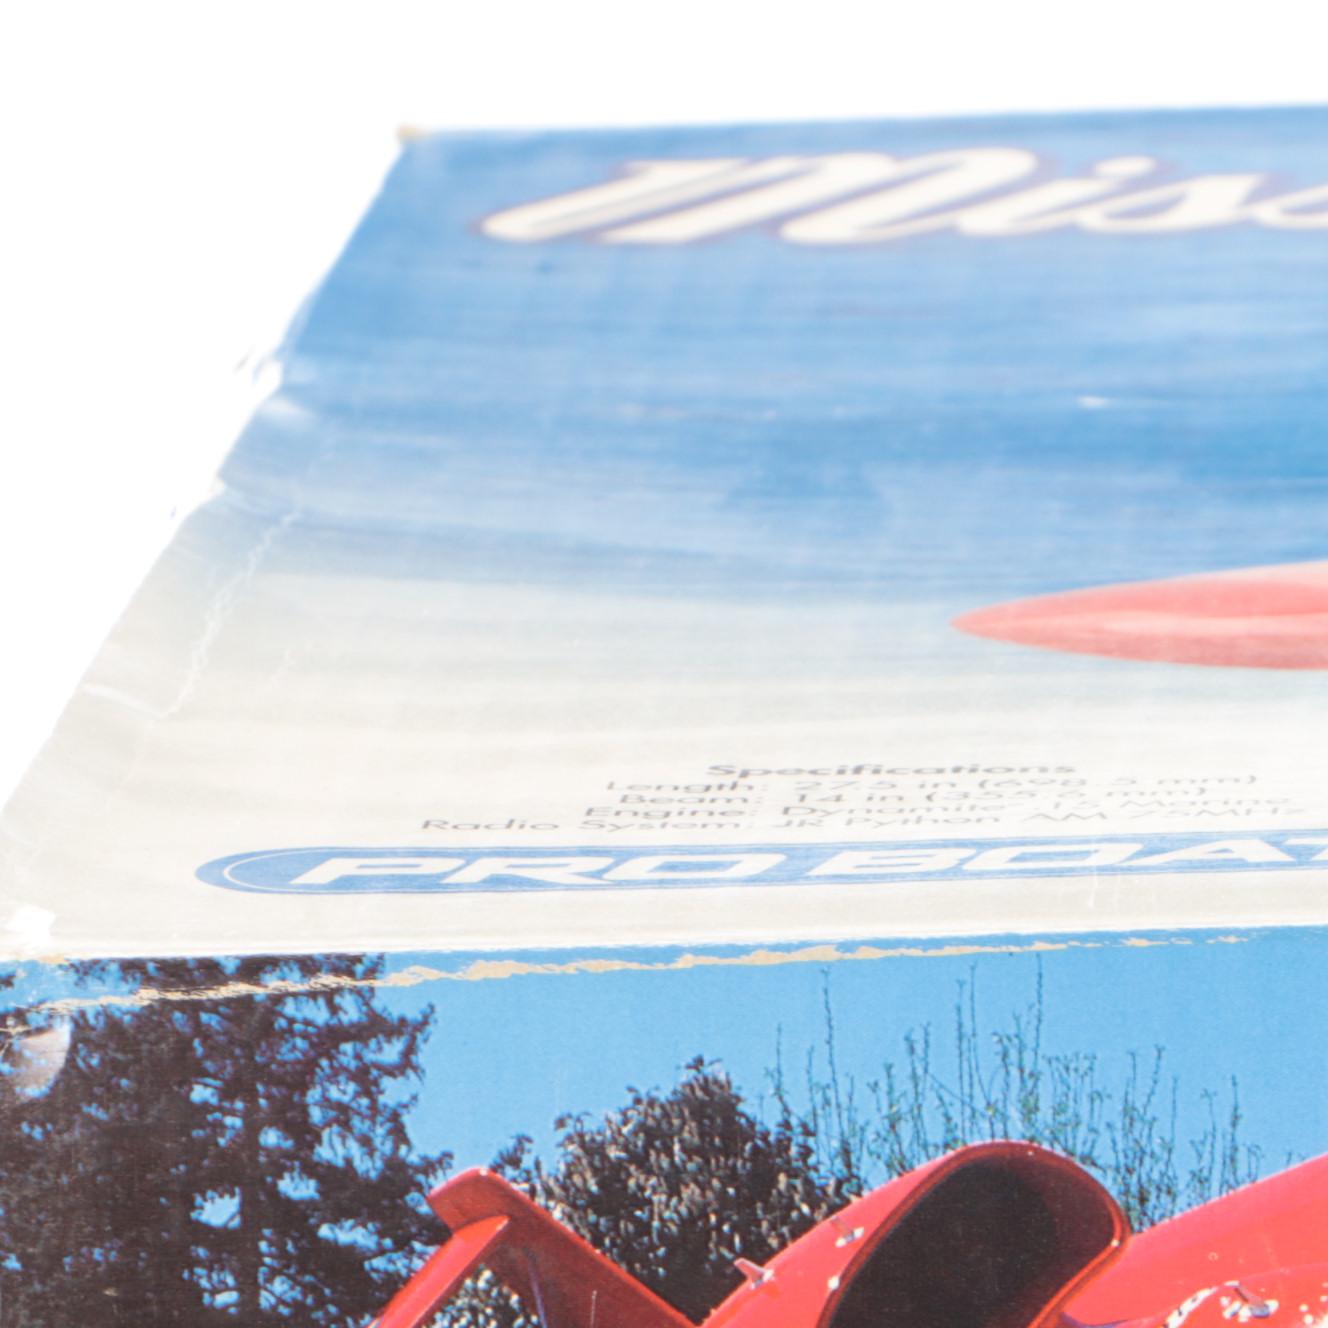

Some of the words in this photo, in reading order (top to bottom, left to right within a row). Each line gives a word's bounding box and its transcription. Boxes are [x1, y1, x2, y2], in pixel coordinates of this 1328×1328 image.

[706, 764, 1077, 779] Specifications
[917, 780, 958, 790] in
[617, 793, 765, 805] Beam:
[796, 793, 846, 804] 14
[864, 792, 906, 803] in
[584, 805, 760, 819] Engine:
[420, 817, 560, 831] Radio
[289, 852, 788, 886] PRO
